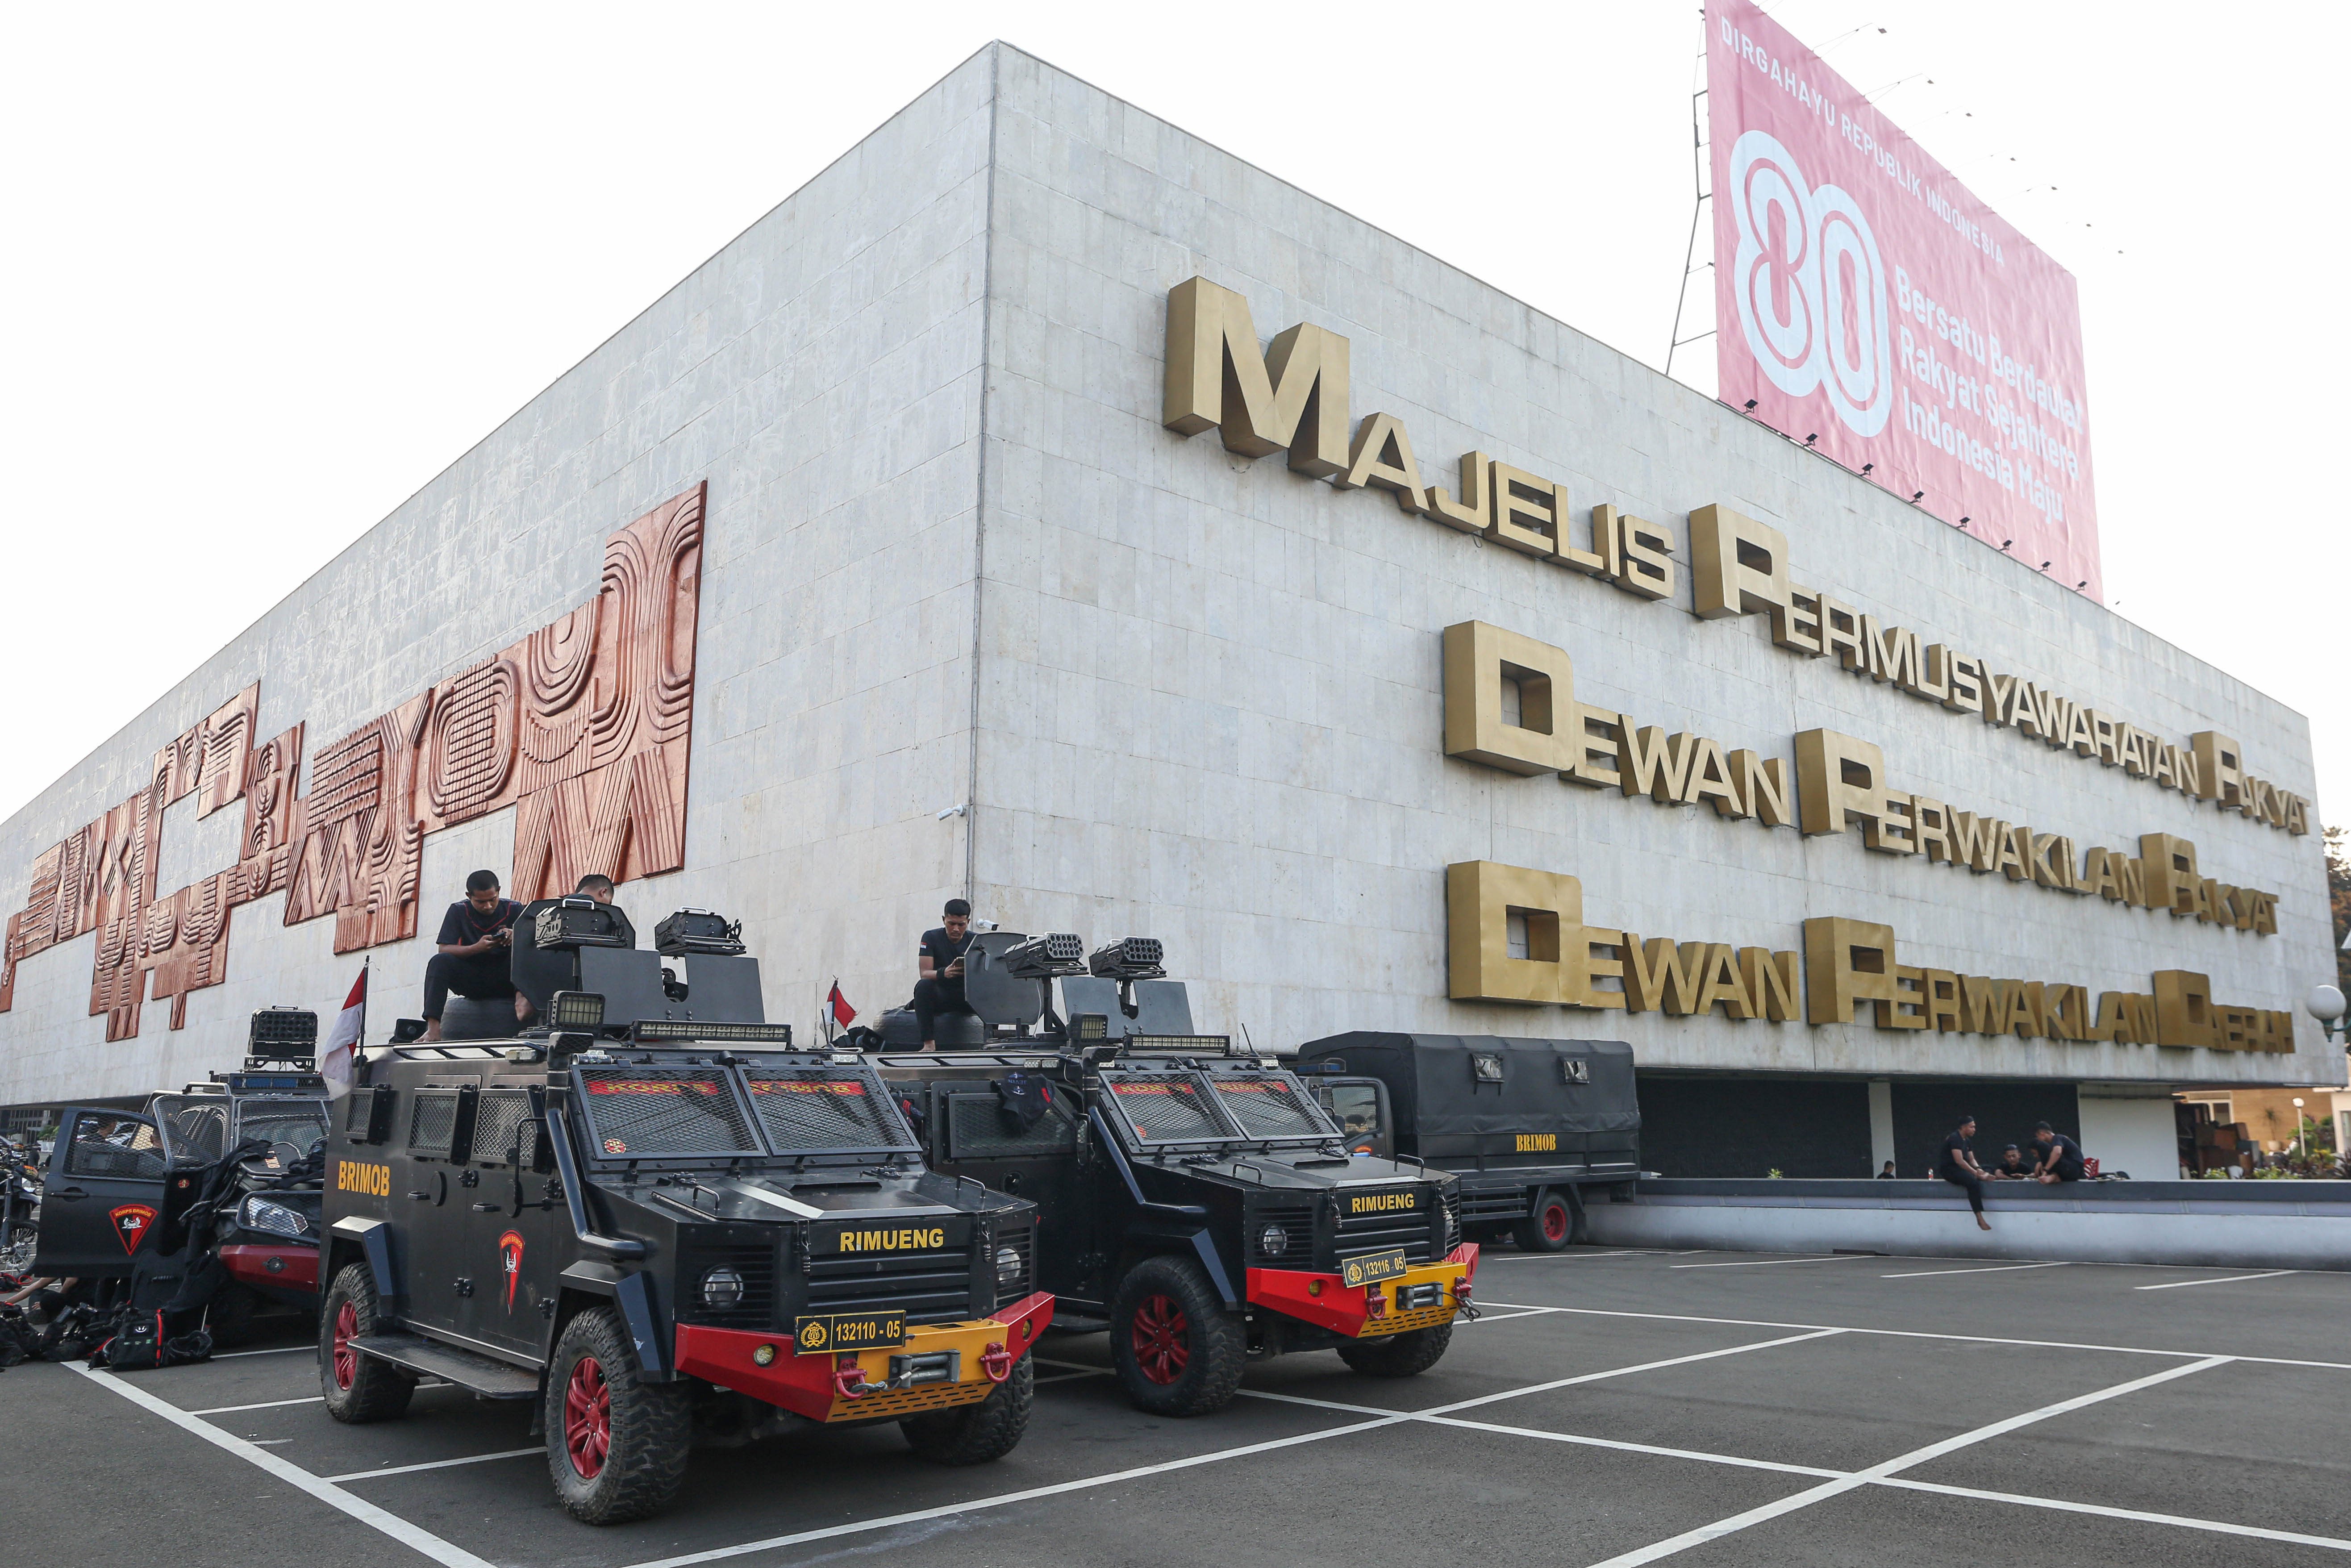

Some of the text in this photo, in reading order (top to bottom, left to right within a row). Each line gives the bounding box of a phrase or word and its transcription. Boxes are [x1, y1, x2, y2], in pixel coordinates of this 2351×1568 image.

[1722, 16, 2005, 267] DIRGAHAYU REPUBLIK INDONESIA
[1730, 130, 1892, 437] 80
[1895, 265, 2083, 435] Bersatu Berdaulat
[1900, 324, 2079, 481] Rakyat Sejahtera
[1903, 386, 2063, 525] Indonesia Maju
[1162, 275, 2311, 835] MAJELIS PERMUSYAWARATAN RAKYAT
[1443, 620, 2280, 935] DEWAN PERWAKILAN RAKYAT
[1447, 860, 2296, 1054] DEWAN PERWAKILAN DAERAH
[338, 1160, 390, 1197] BRIMOB
[1352, 1193, 1414, 1213] RIMUENG
[1516, 1134, 1556, 1151] BRIMOB
[133, 1209, 152, 1217] BRIMOB
[840, 1228, 944, 1251] RIMUENG
[1366, 1259, 1390, 1276] 132116
[1394, 1256, 1404, 1271] 05
[836, 1322, 876, 1341] 132110
[887, 1320, 900, 1338] 05
